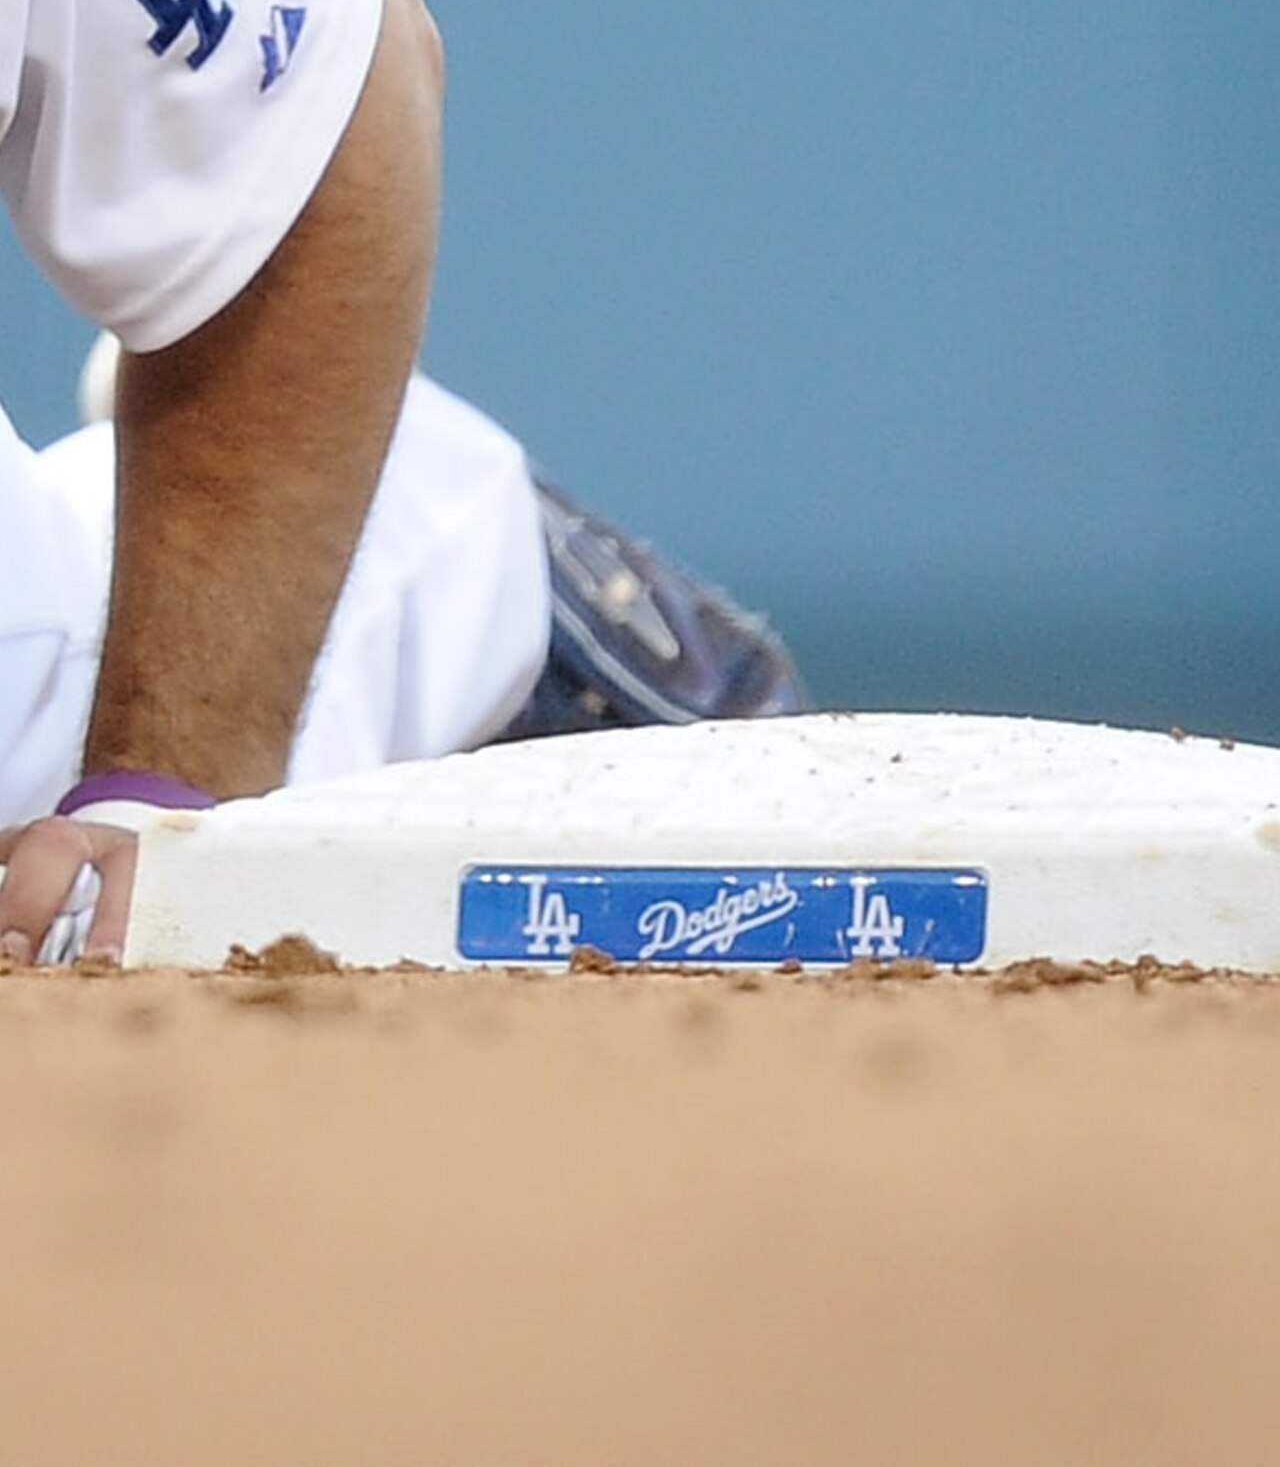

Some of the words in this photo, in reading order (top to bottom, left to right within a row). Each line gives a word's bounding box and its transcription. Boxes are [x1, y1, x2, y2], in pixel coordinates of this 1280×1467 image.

[523, 875, 580, 954] LA
[639, 873, 799, 959] Dodgers
[847, 876, 903, 956] LA
